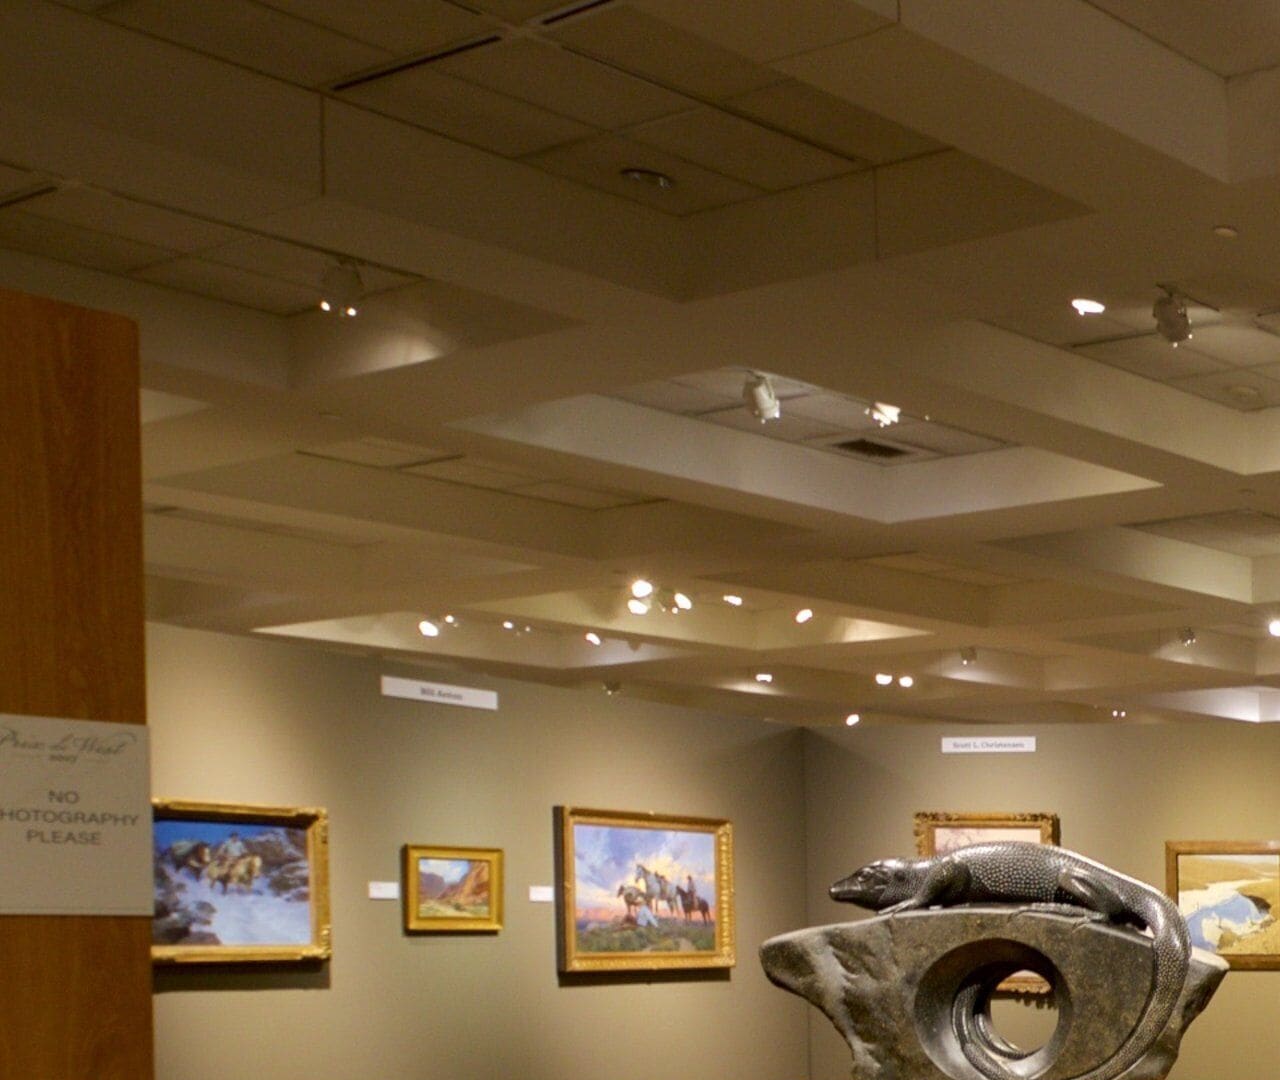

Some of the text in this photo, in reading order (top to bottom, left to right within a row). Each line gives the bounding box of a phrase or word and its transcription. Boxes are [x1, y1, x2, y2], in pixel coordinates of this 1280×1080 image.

[48, 790, 80, 804] NO
[0, 808, 139, 826] HOTOGRAPHY
[26, 829, 101, 845] PLEASE
